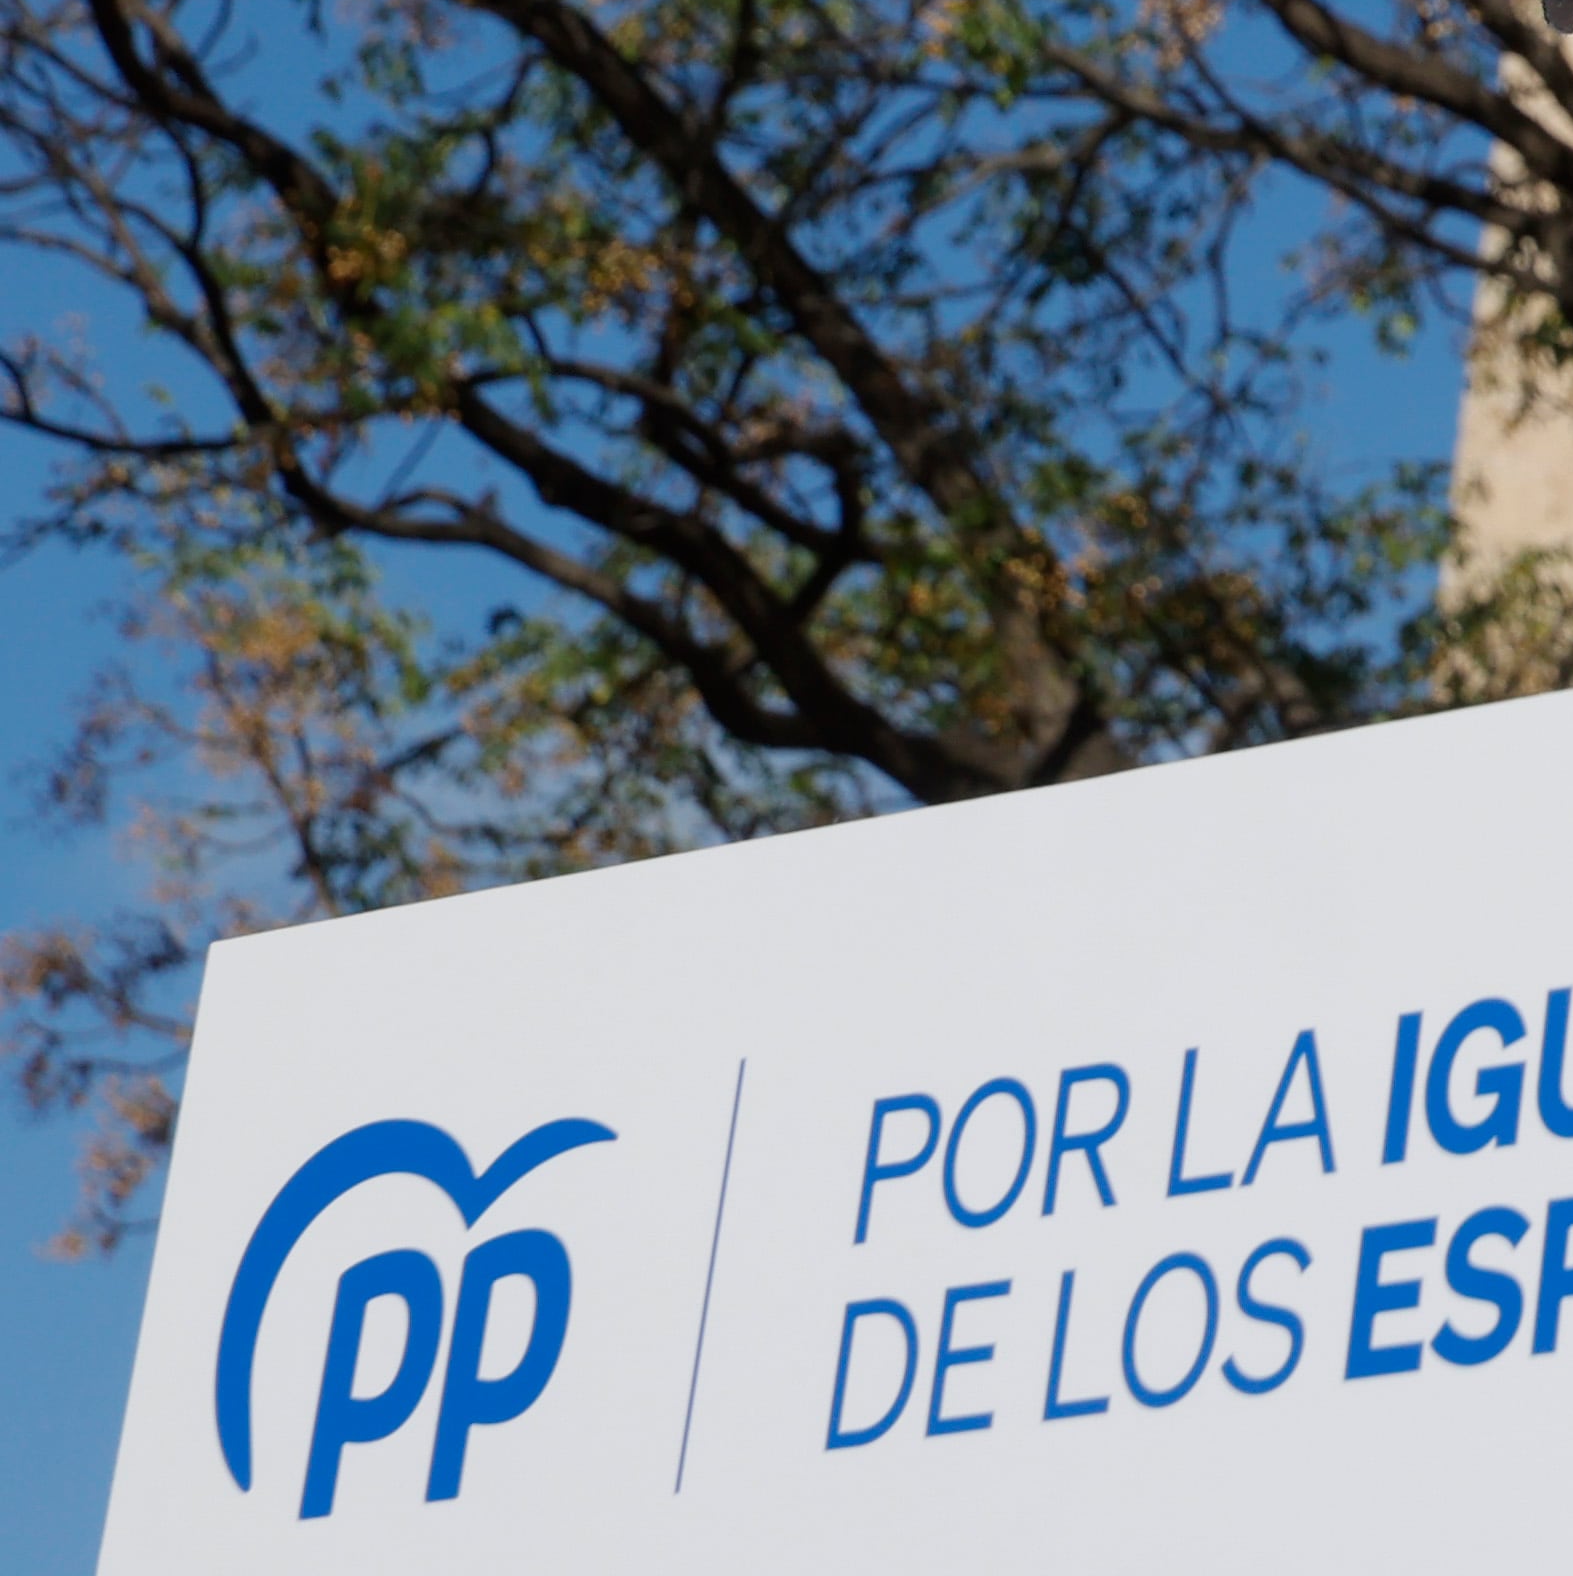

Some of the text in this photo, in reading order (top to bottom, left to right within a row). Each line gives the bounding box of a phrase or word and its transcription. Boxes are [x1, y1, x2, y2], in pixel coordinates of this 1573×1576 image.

[854, 1064, 1130, 1243] POR
[1168, 1031, 1336, 1197] LA
[826, 1273, 1011, 1449] DE
[1044, 1238, 1311, 1420] LOS
